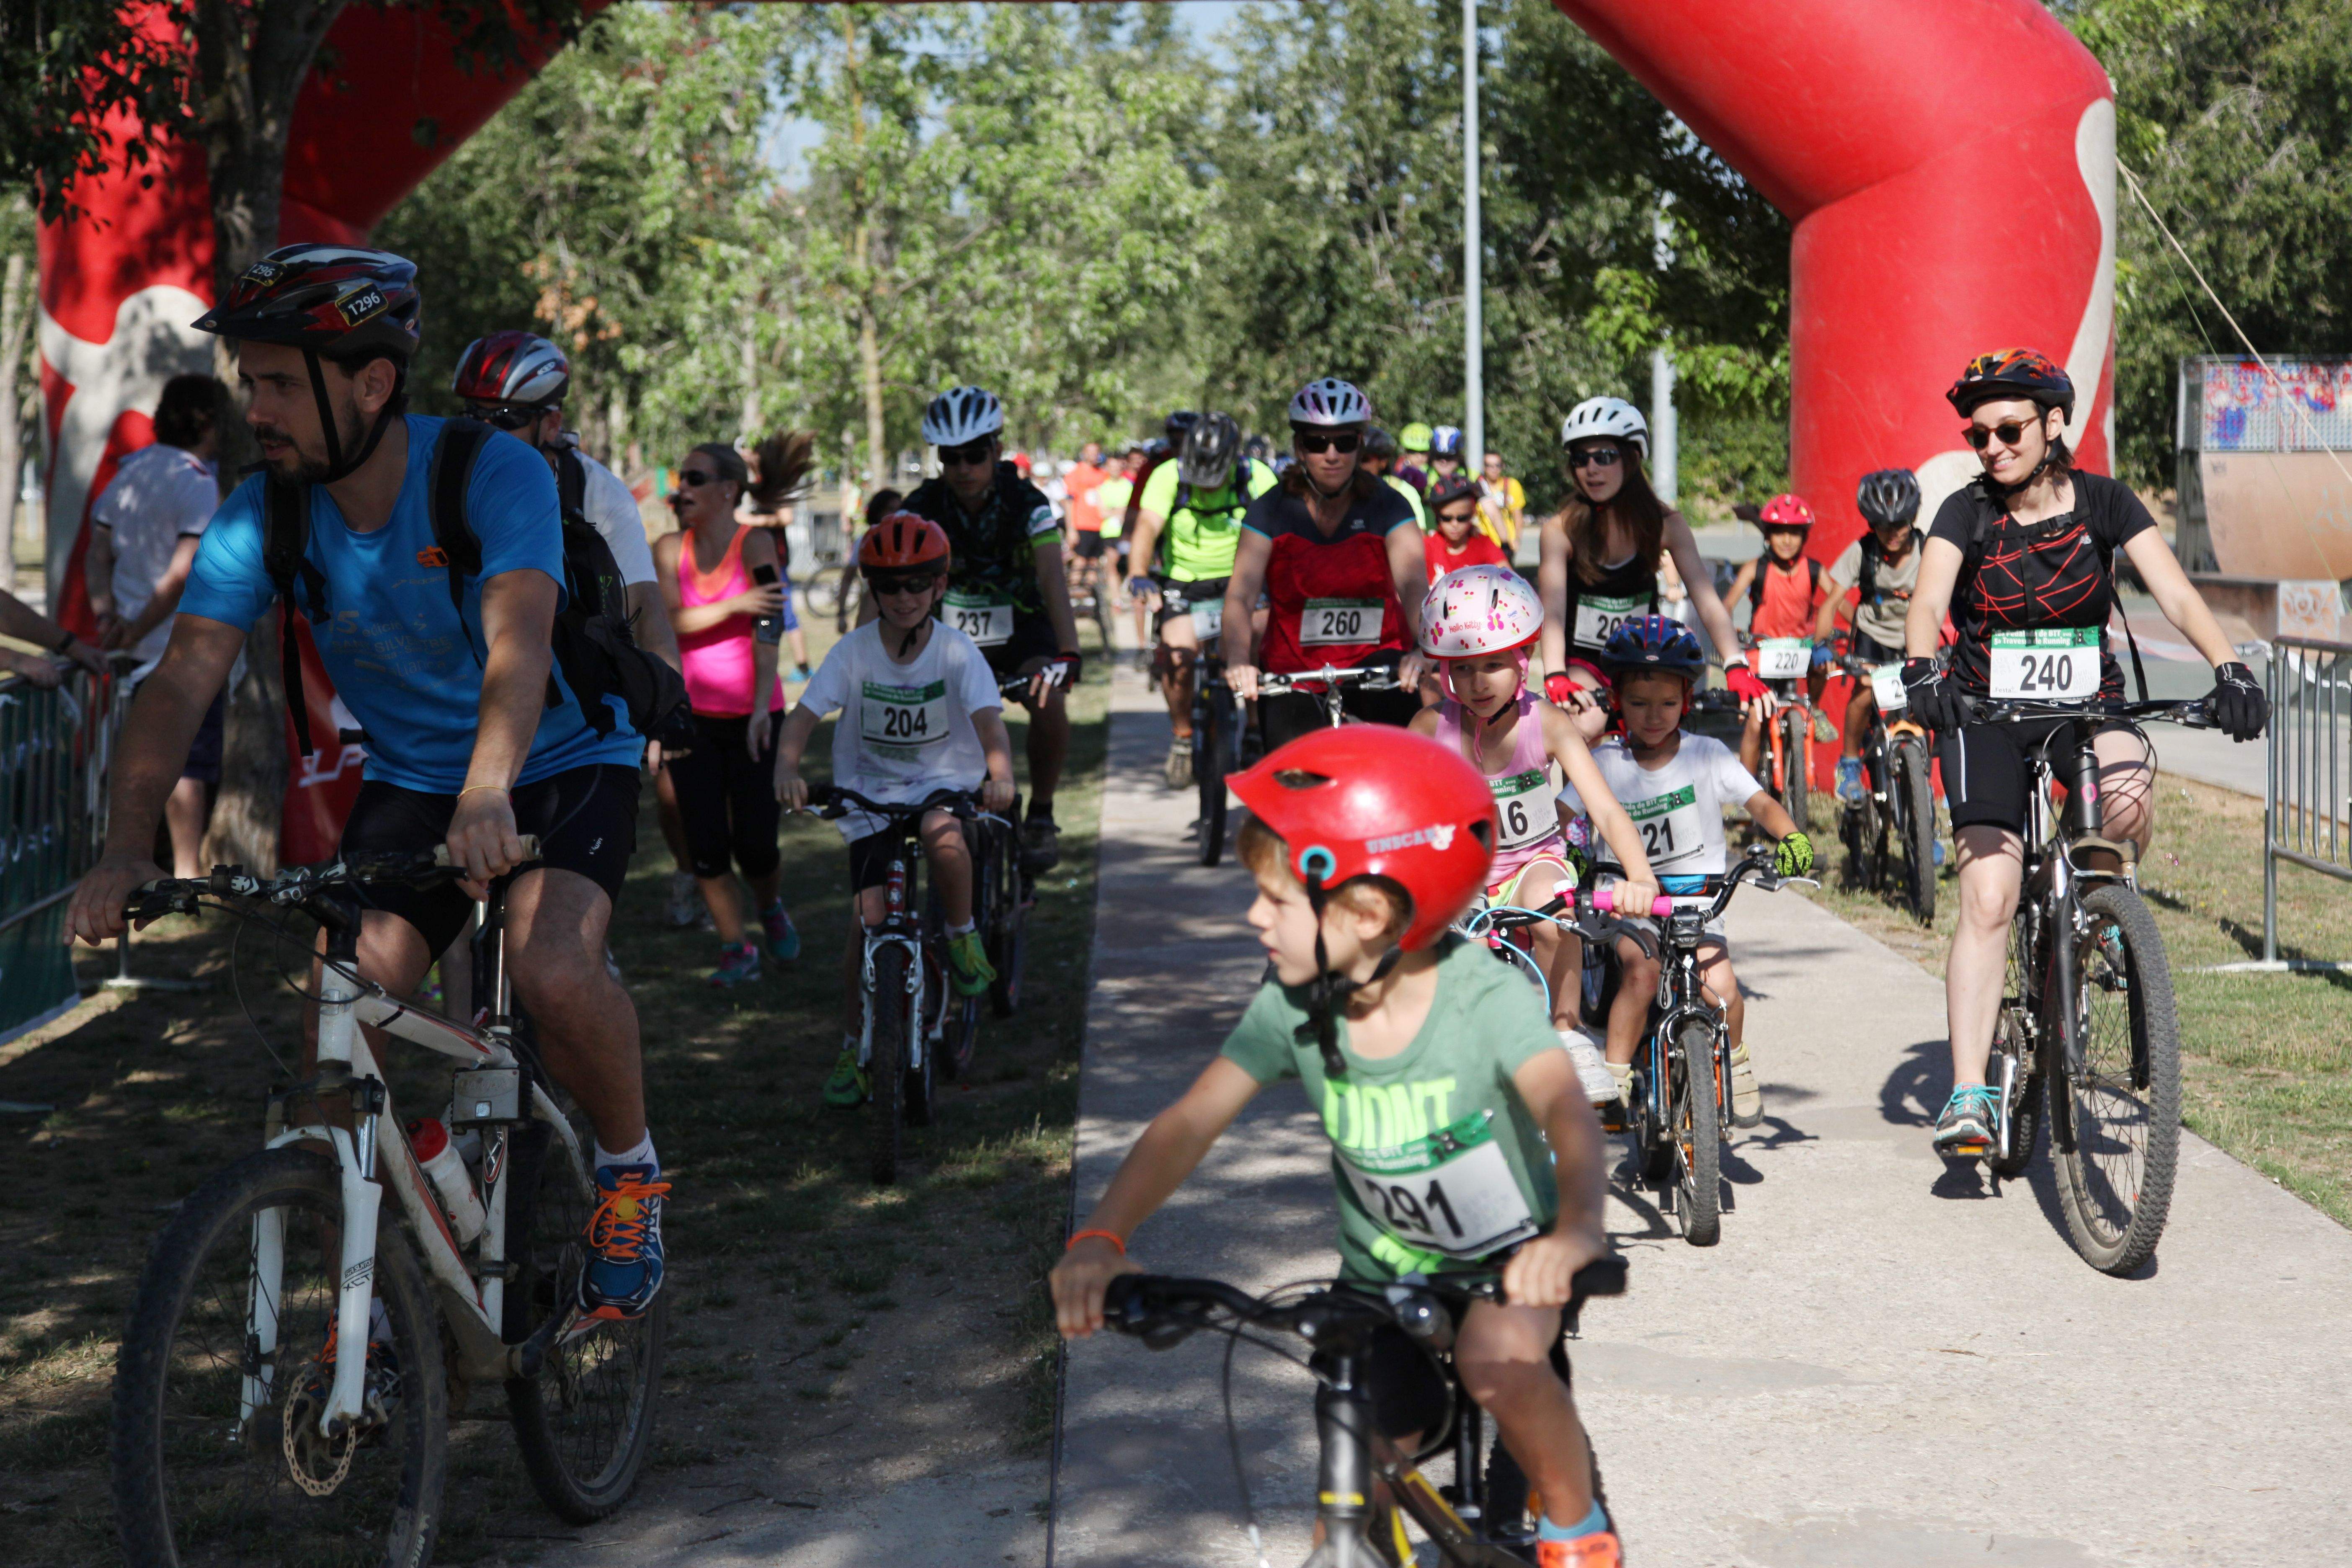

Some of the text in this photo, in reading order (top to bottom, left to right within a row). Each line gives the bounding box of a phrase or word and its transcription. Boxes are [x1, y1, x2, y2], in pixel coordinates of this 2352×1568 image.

[348, 292, 381, 316] 1296
[957, 611, 992, 636] 237
[1322, 610, 1361, 636] 260
[1596, 614, 1632, 640] 20
[2043, 636, 2071, 645] Running
[1775, 653, 1799, 670] 220
[2020, 655, 2073, 691] 240
[884, 707, 927, 738] 204
[1642, 803, 1668, 816] Running
[1637, 818, 1674, 857] 21
[1365, 1179, 1465, 1238] 291
